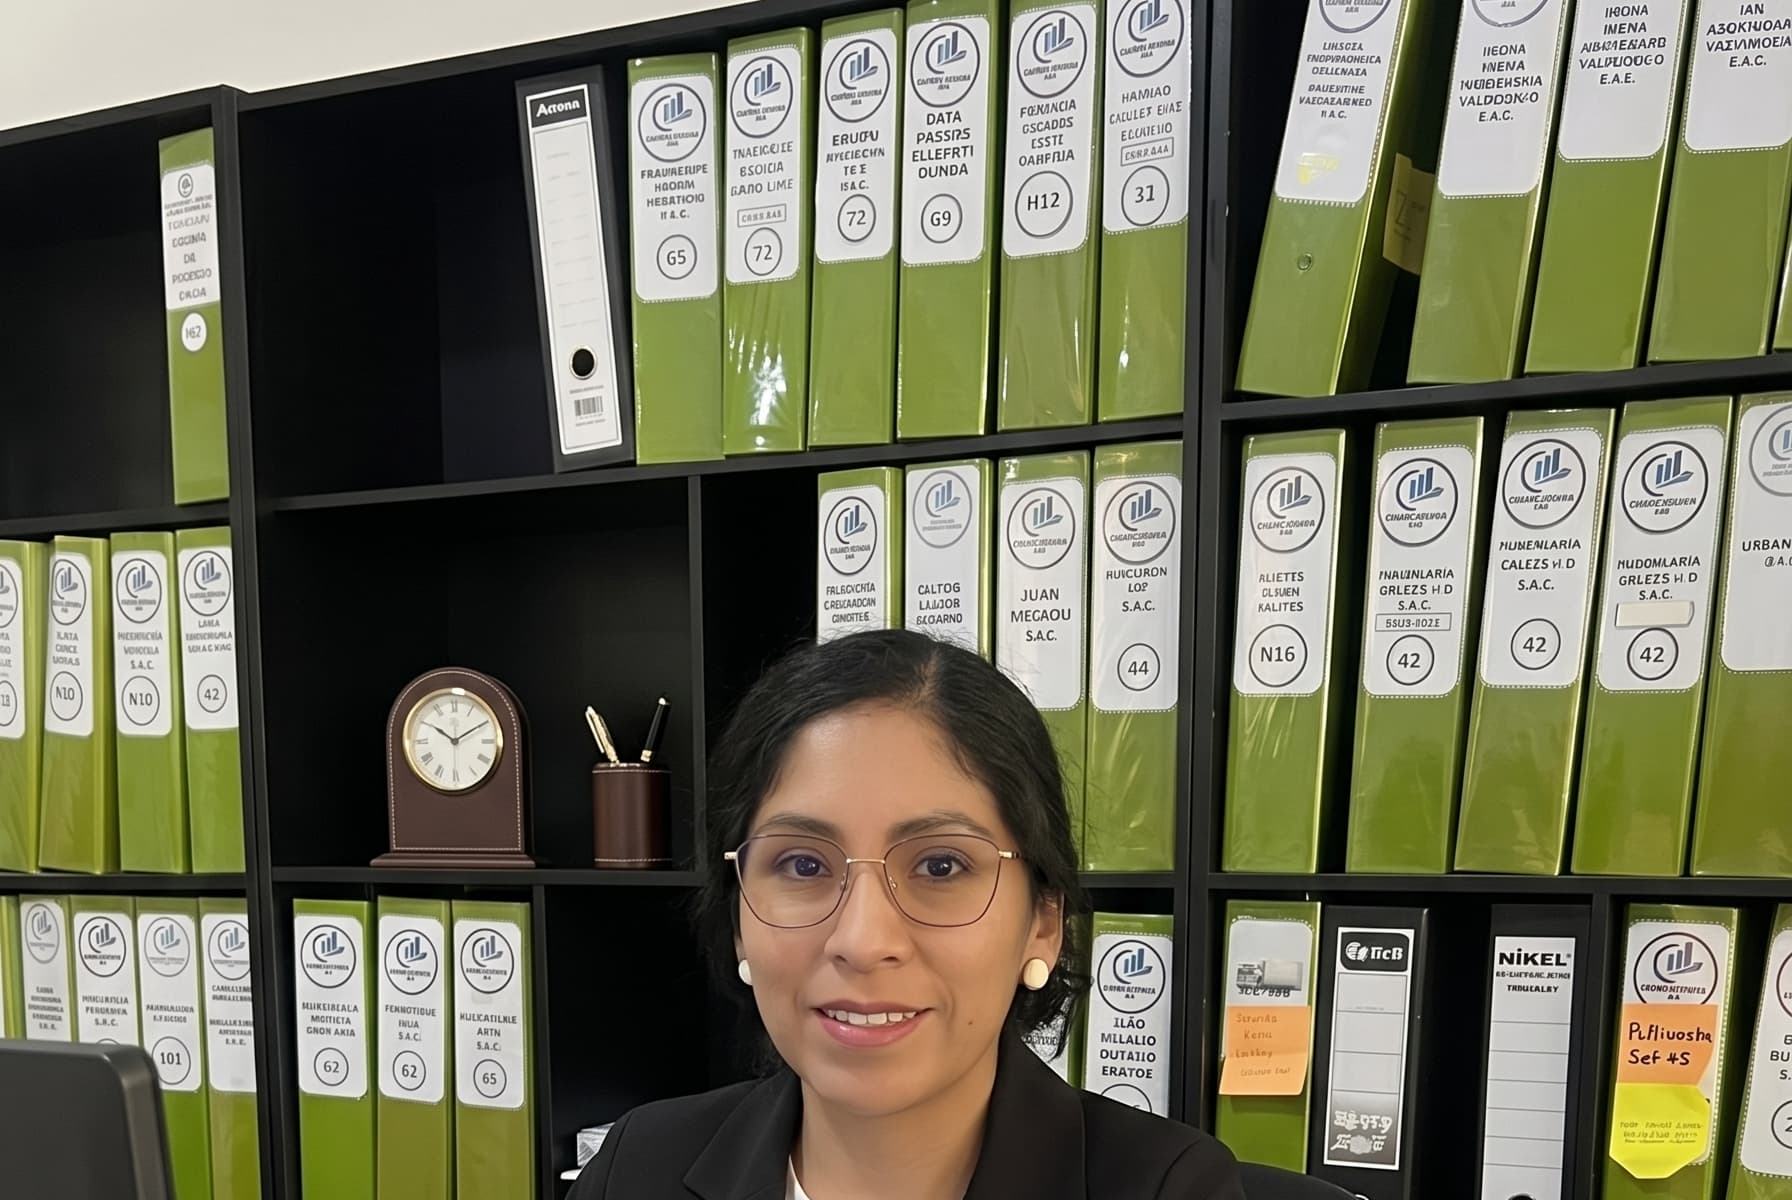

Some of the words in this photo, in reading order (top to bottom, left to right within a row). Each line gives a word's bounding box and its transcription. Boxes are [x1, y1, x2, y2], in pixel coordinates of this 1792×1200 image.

[926, 110, 962, 126] DATA
[1134, 185, 1155, 204] 31
[1027, 192, 1060, 212] H12
[846, 210, 866, 226] 72
[930, 210, 951, 227] G9
[752, 244, 773, 262] 72
[1501, 558, 1549, 571] CALEZS
[1517, 579, 1555, 591] S.A.C.
[1618, 573, 1670, 586] GRLEZS
[1020, 588, 1060, 602] JUAN
[1638, 588, 1673, 600] S.A.C.
[1121, 600, 1156, 613] S.A.C.
[1398, 600, 1431, 611] S.A.C.
[1025, 629, 1057, 642] S.A.C.
[1522, 636, 1547, 653] 42
[1260, 646, 1295, 663] N16
[1397, 652, 1421, 669] 42
[1639, 646, 1665, 663] 42
[1127, 660, 1149, 676] 44
[129, 692, 153, 706] N10
[204, 688, 220, 700] 42
[160, 1051, 182, 1066] 101
[323, 1060, 340, 1073] 62
[401, 1064, 418, 1078] 62
[482, 1071, 497, 1085] 65
